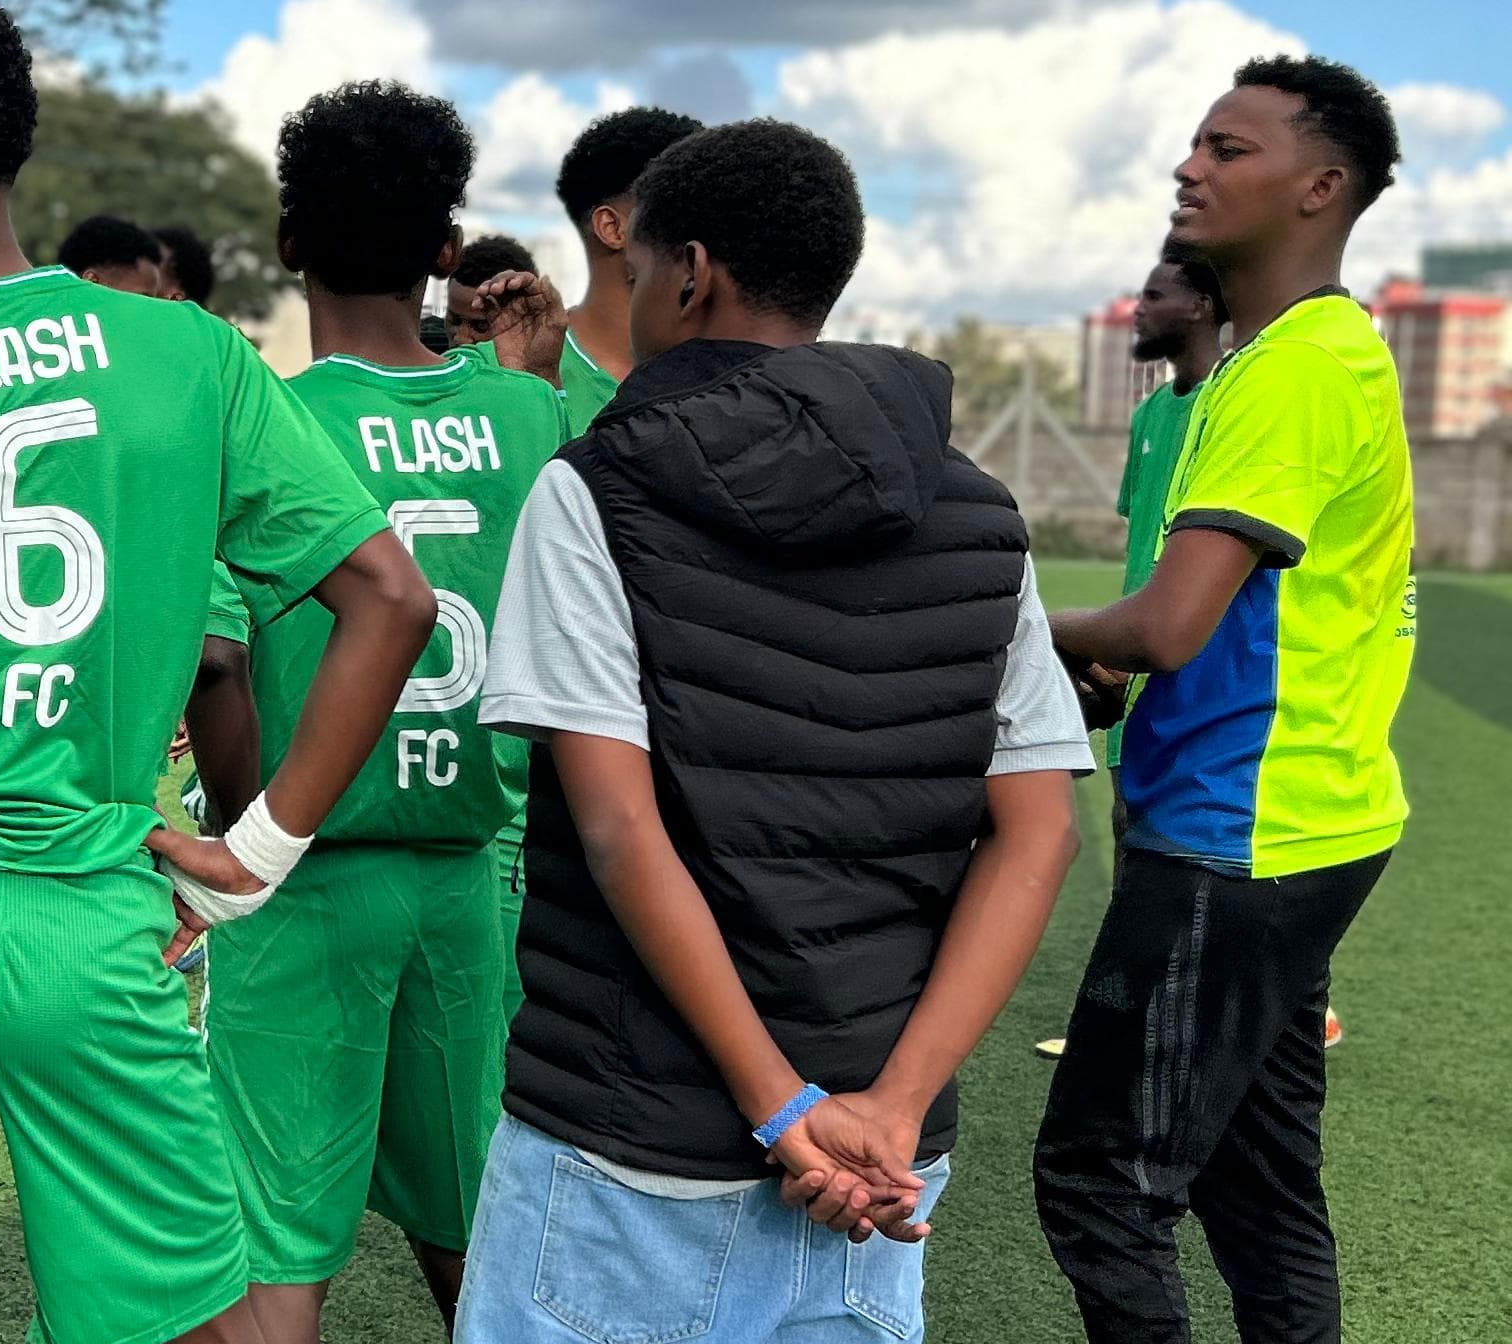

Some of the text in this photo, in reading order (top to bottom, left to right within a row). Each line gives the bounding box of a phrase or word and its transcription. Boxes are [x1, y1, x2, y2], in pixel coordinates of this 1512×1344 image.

[357, 415, 502, 474] FLASH
[386, 498, 488, 713] 5
[1, 662, 76, 729] FC
[397, 728, 460, 790] FC
